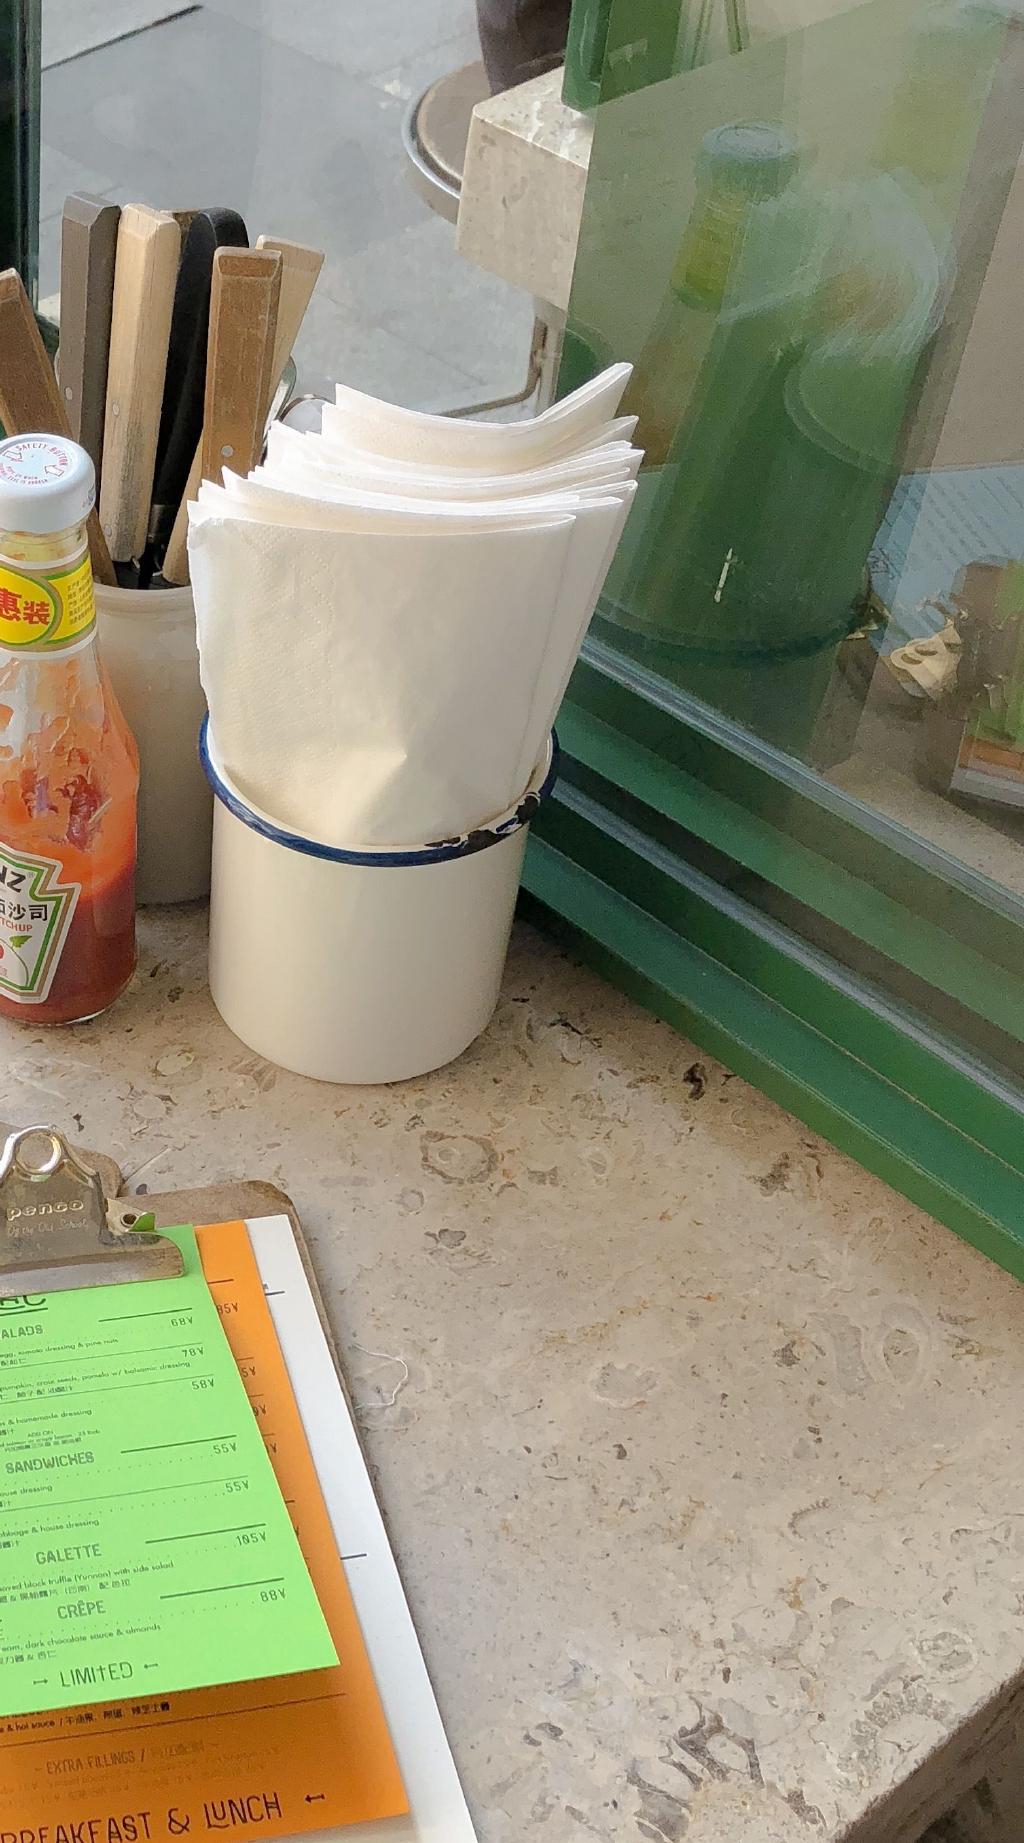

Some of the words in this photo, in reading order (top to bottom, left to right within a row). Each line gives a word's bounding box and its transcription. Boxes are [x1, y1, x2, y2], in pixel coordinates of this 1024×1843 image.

[6, 1200, 84, 1221] penco
[4, 1450, 96, 1474] SANDWICHES
[34, 1543, 103, 1565] GALETTE
[55, 1596, 107, 1620] CRÊPE
[24, 1639, 45, 1649] dark
[58, 1660, 135, 1688] LIMITED
[31, 1720, 56, 1730] sauce
[46, 1756, 84, 1775] EXTRA
[87, 1750, 136, 1768] FILLINGS
[168, 1808, 190, 1834] &
[204, 1792, 282, 1829] LUNCH
